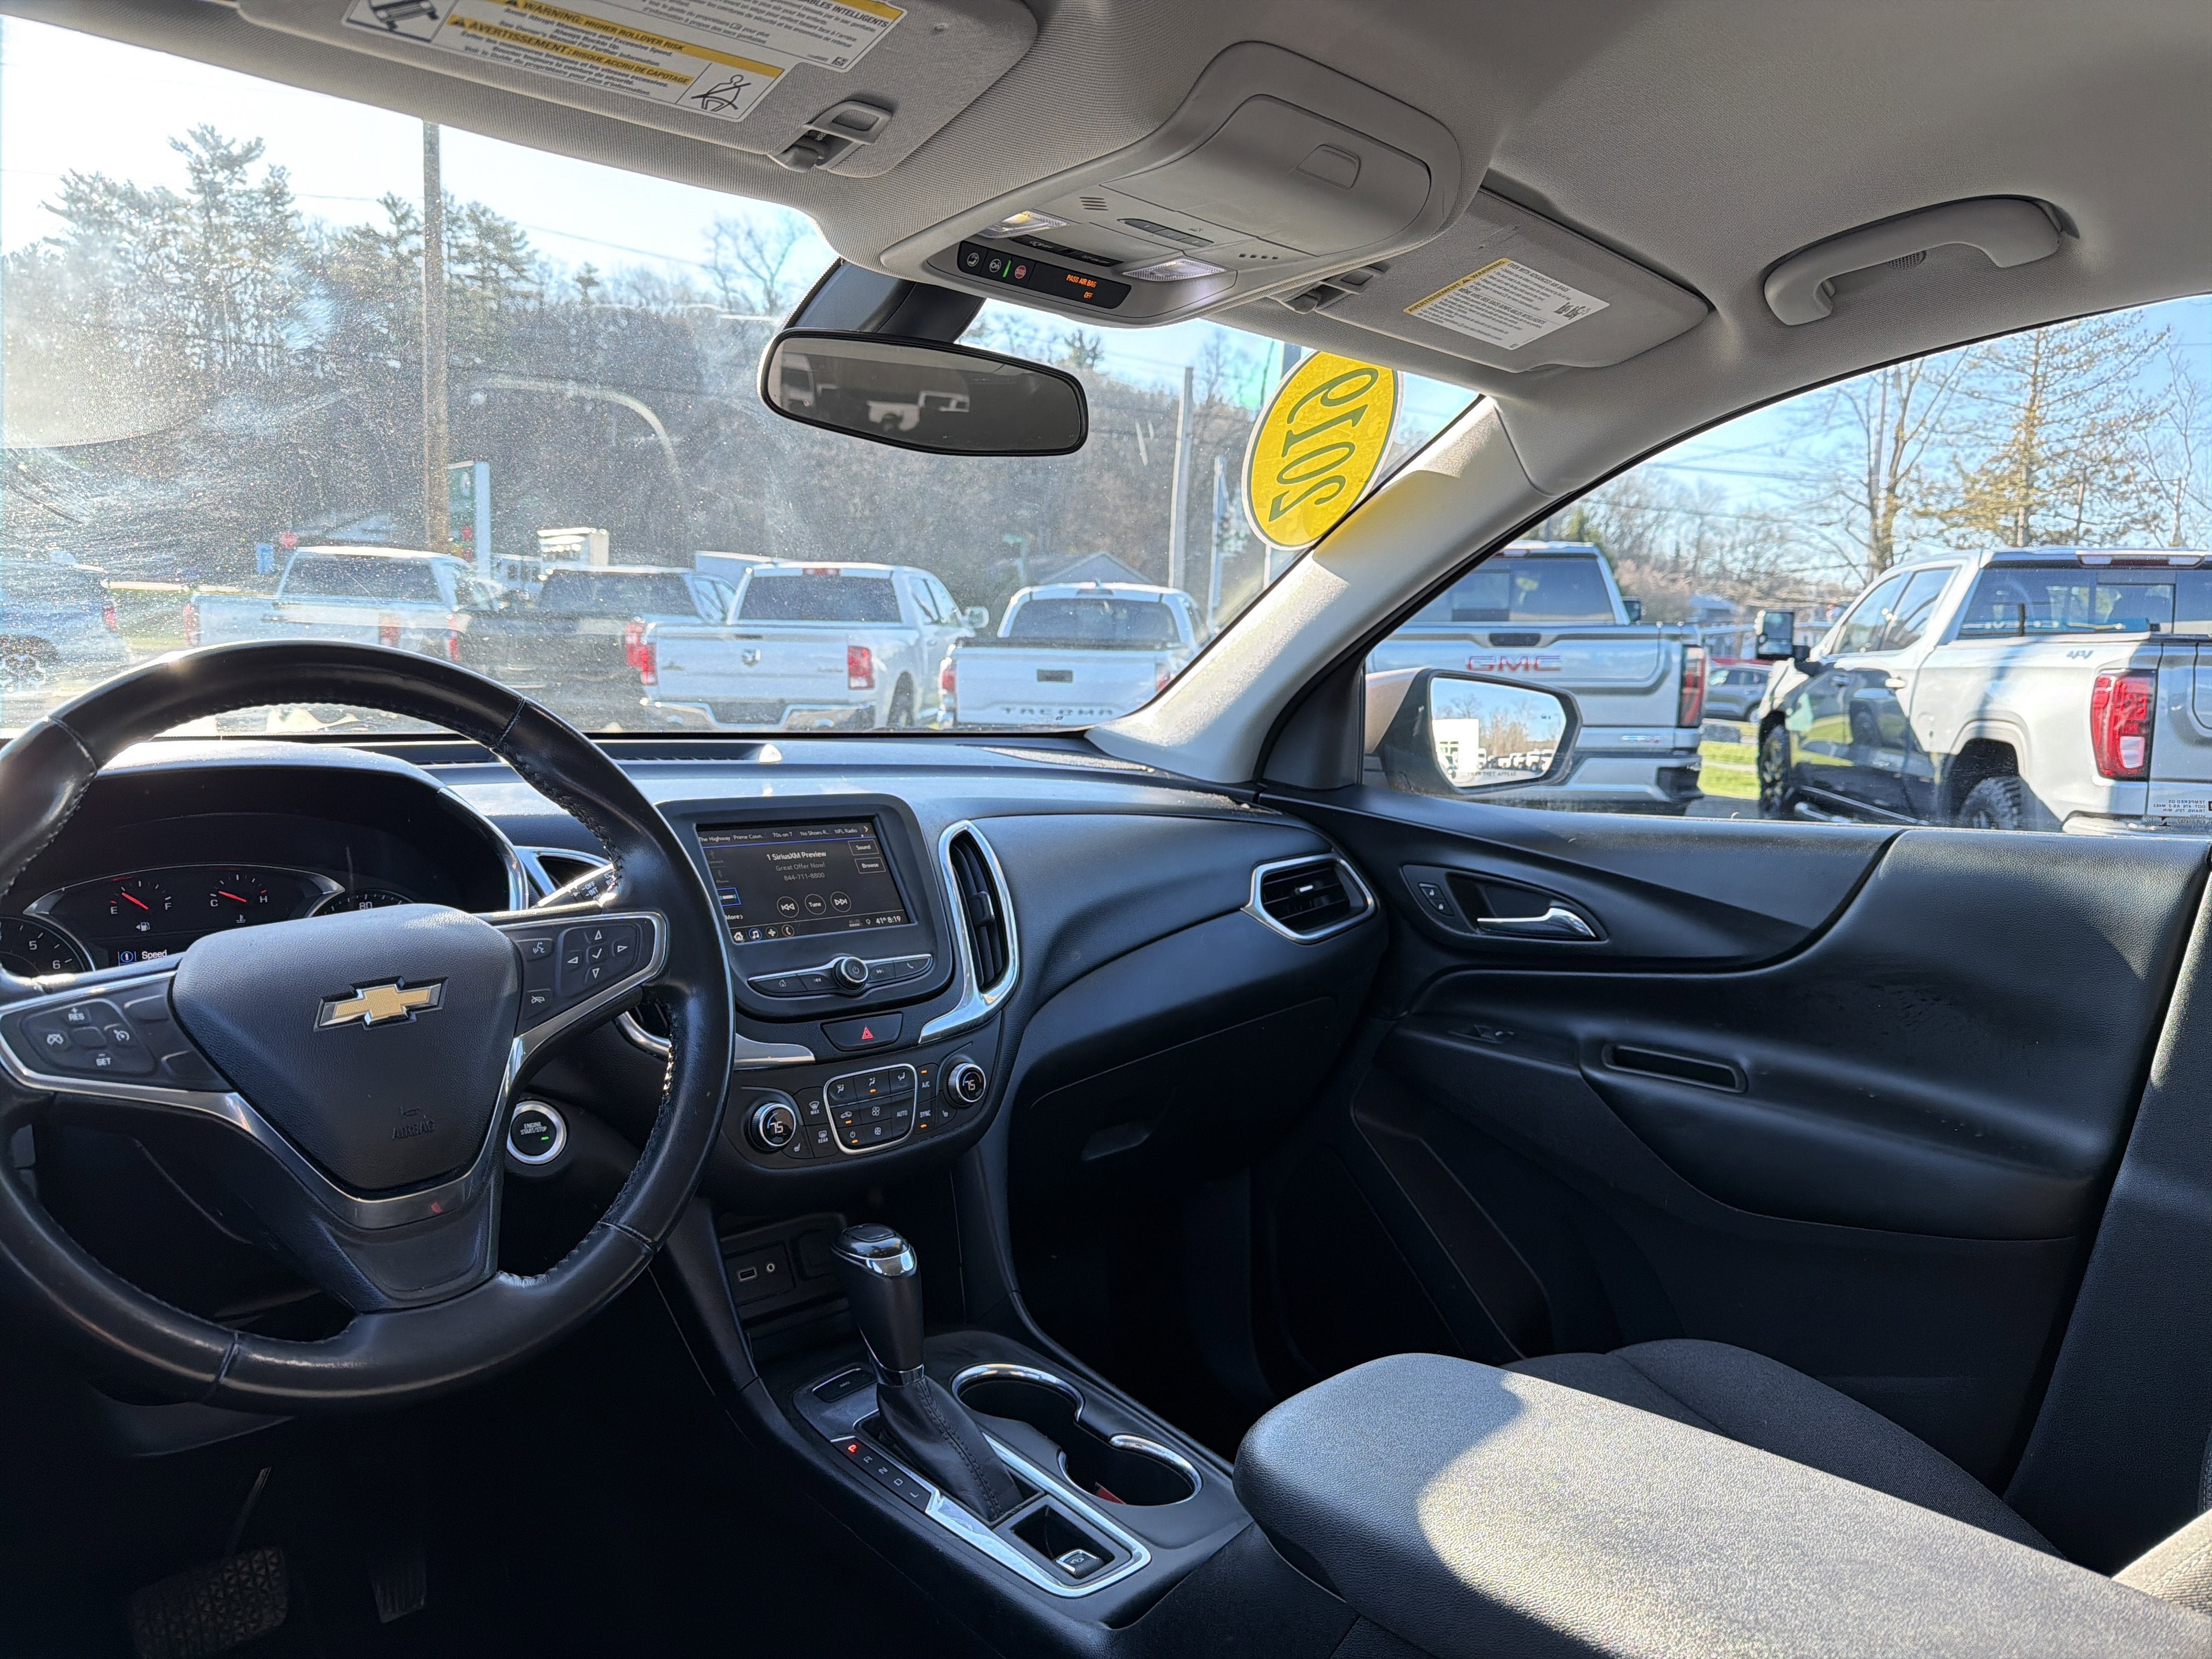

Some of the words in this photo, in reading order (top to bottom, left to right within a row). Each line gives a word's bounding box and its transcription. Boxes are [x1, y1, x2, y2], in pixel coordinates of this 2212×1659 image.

[833, 5, 889, 27] INTELLIGENTS
[584, 21, 617, 33] HIGHER
[618, 30, 663, 46] ROLLOVER
[663, 42, 685, 50] RISK
[613, 38, 648, 50] Excessive
[572, 50, 605, 63] RISQUE
[603, 59, 634, 70] ACCRU
[647, 67, 690, 85] CAPOTAGE
[1471, 261, 1505, 279] WARNING
[1066, 274, 1079, 284] PASS
[1087, 279, 1097, 288] BAG
[1084, 291, 1093, 300] OFF
[1408, 284, 1461, 312] AVERTISSEMENT
[1466, 655, 1563, 672] GMC
[772, 852, 801, 861] SiriusXM
[784, 872, 825, 881] 844-711-8800
[210, 899, 218, 907] C
[259, 895, 268, 904] H
[165, 902, 172, 911] F
[359, 901, 373, 910] 80
[110, 906, 118, 915] E
[876, 916, 886, 924] 41°
[29, 940, 37, 950] 5
[142, 949, 167, 960] Speed
[52, 960, 61, 969] 6
[68, 1013, 85, 1022] RES
[96, 1057, 111, 1066] SET
[965, 1080, 975, 1091] 75
[919, 1110, 931, 1118] SYNC
[520, 1126, 548, 1135] START/STOP
[770, 1121, 783, 1134] 75
[848, 1444, 857, 1453] P
[863, 1455, 873, 1464] R
[878, 1466, 888, 1475] N
[894, 1478, 904, 1486] D
